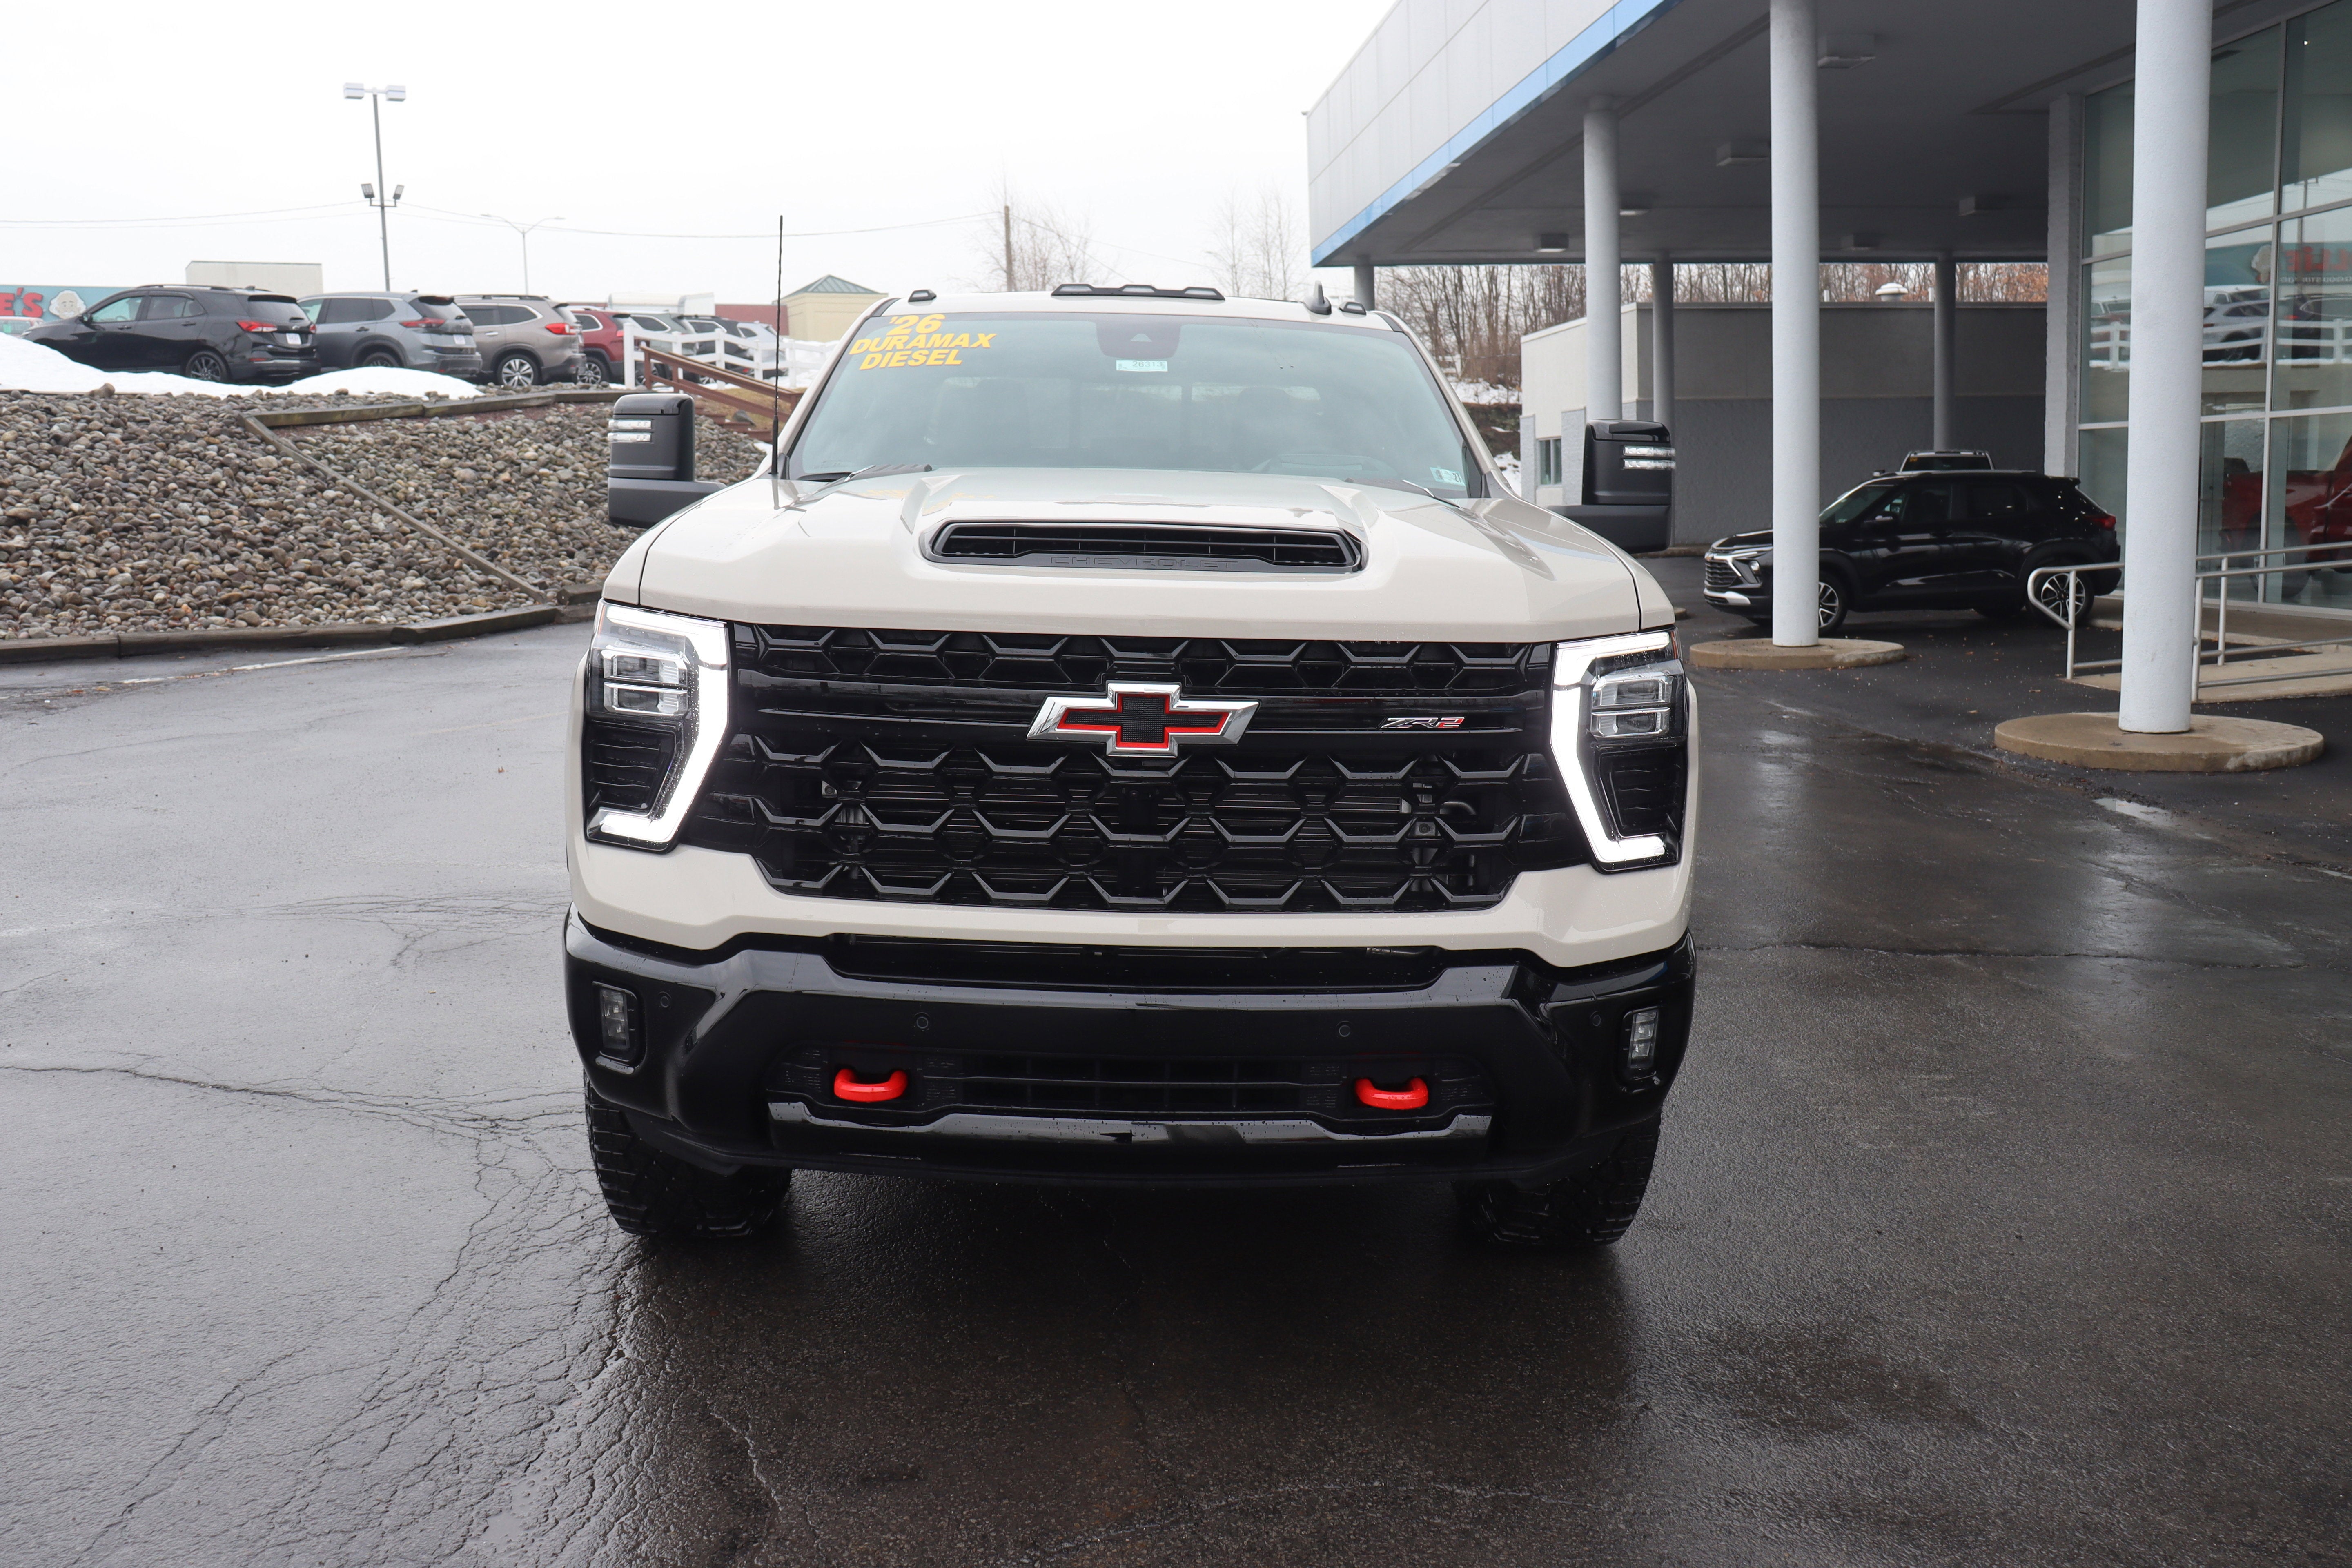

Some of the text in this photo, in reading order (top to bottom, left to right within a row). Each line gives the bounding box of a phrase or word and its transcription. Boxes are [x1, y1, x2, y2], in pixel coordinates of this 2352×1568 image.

[886, 314, 946, 336] '26
[849, 333, 997, 354] DURAMAX
[859, 349, 962, 370] DIESEL
[1051, 556, 1238, 568] CHEVROLET
[1381, 717, 1465, 728] ZR2
